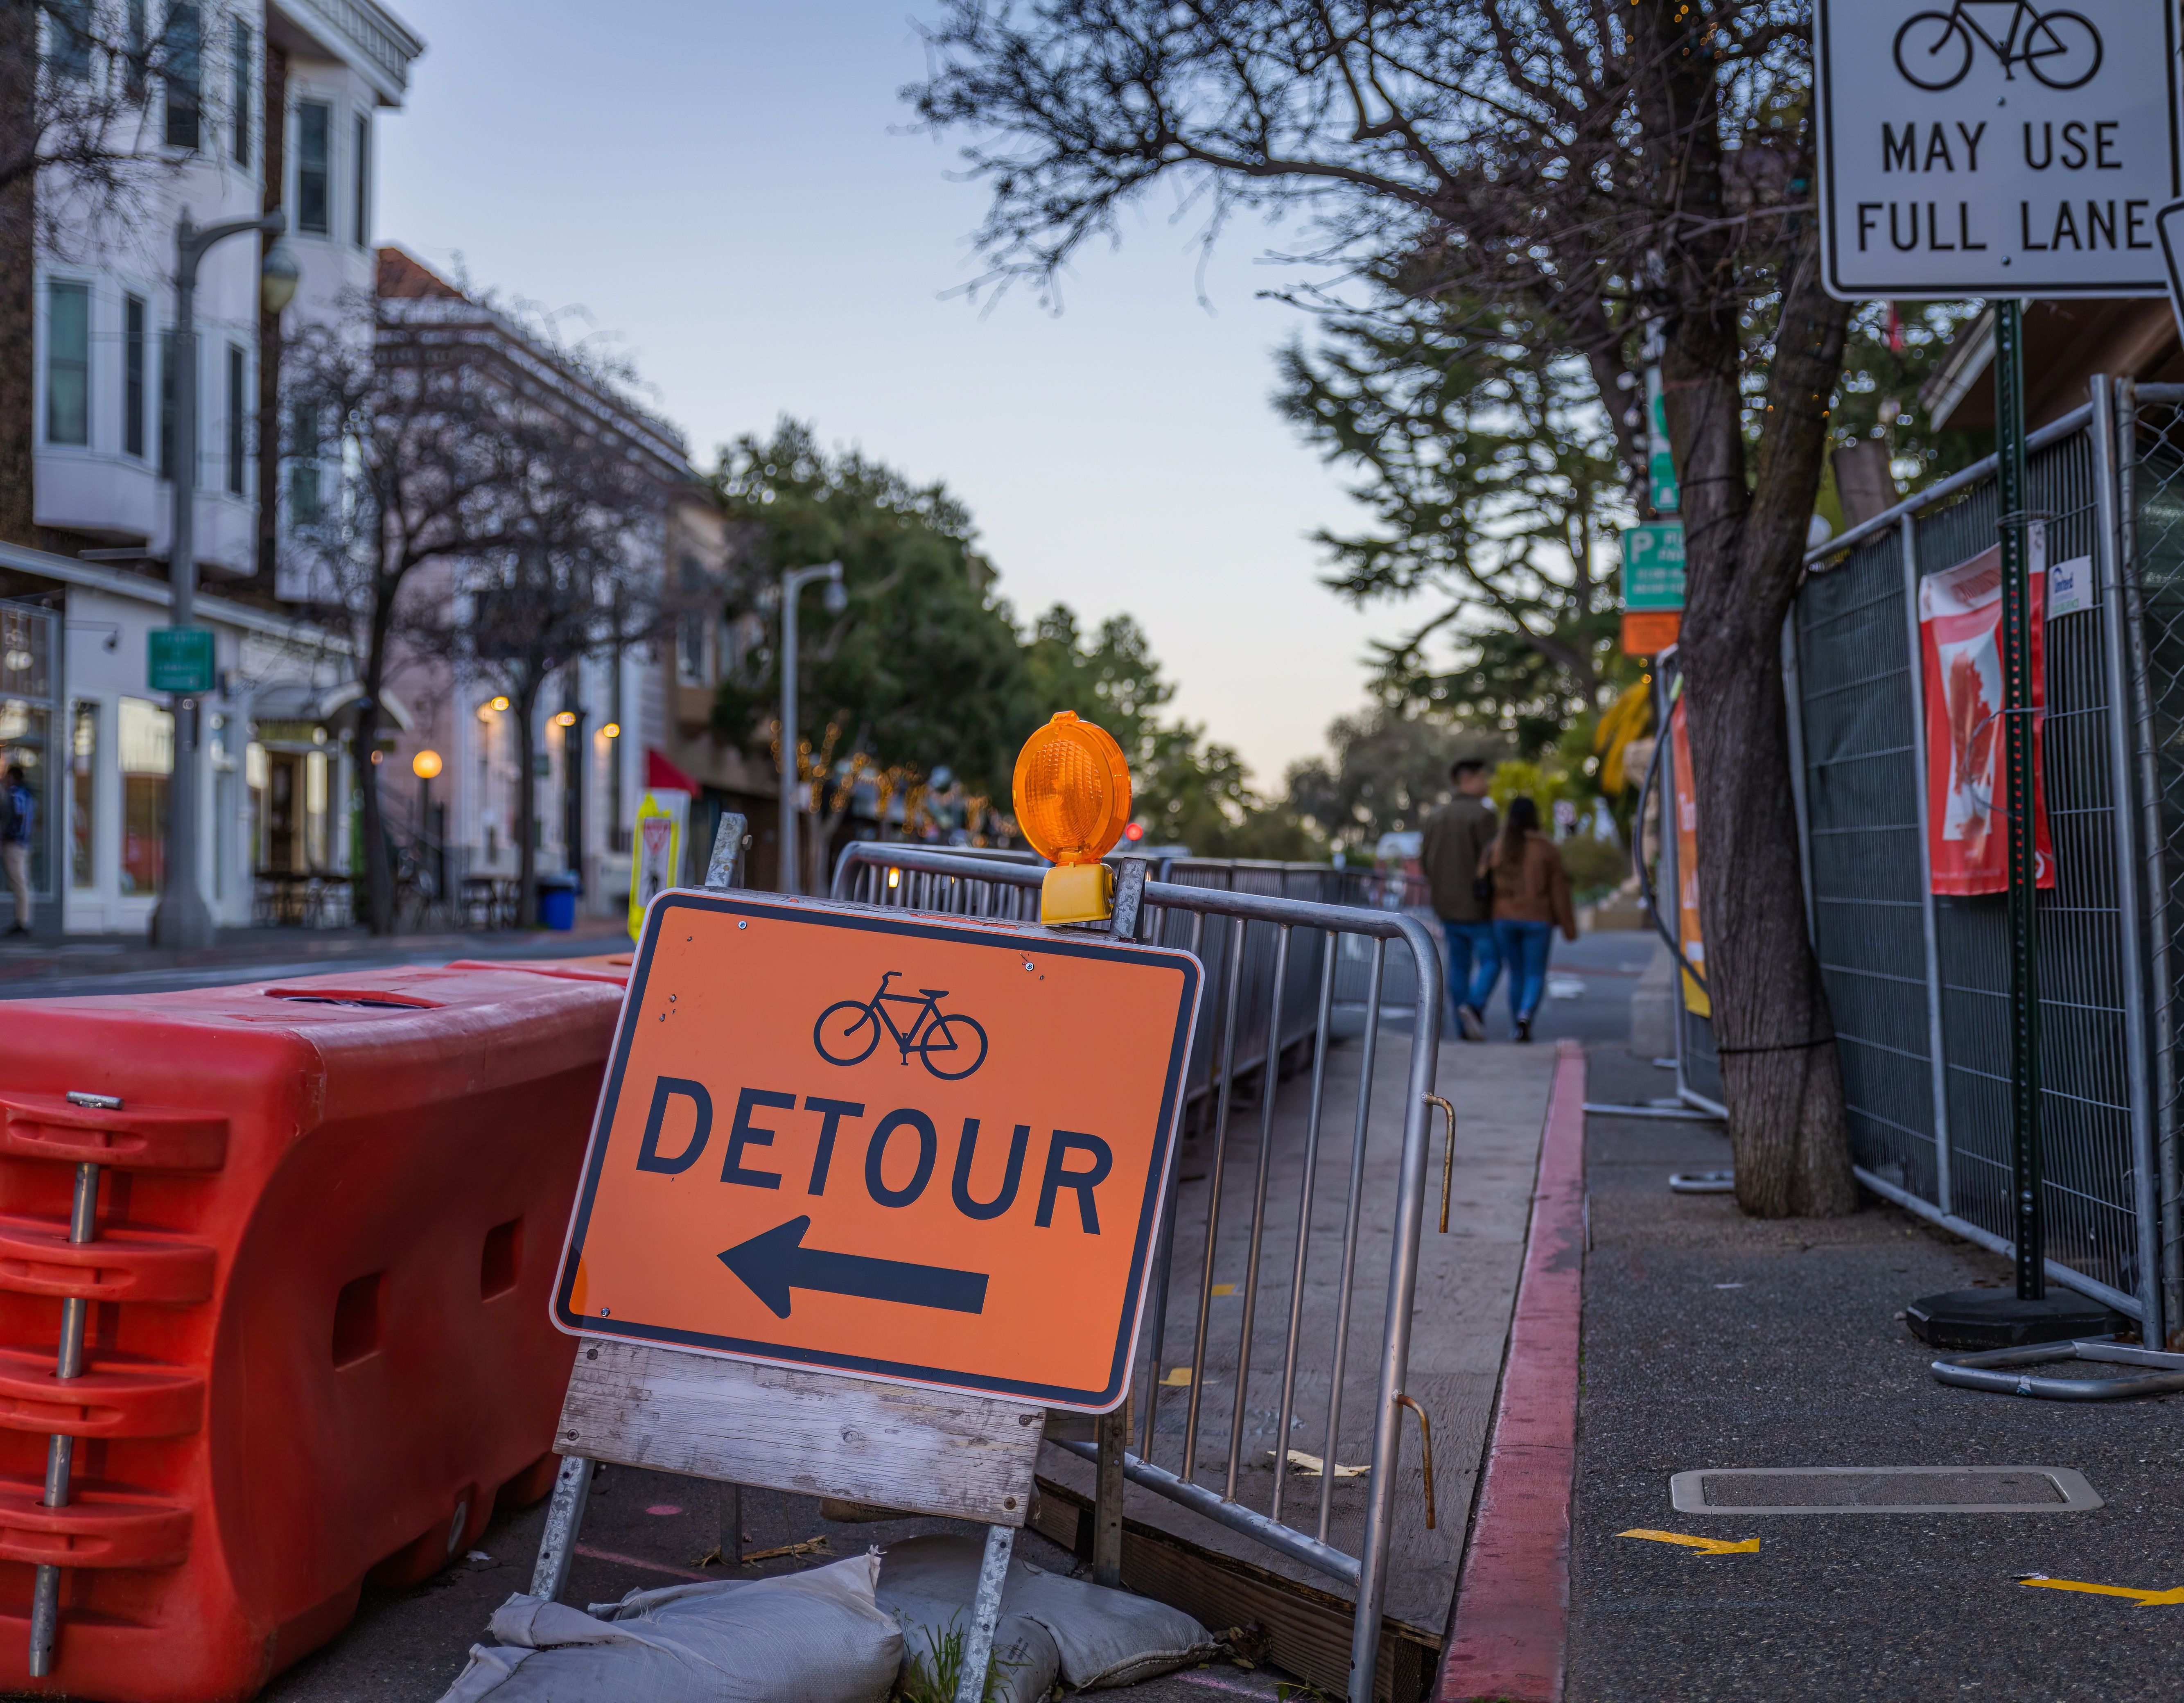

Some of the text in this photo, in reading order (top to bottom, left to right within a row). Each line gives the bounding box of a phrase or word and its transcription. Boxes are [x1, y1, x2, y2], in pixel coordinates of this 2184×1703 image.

[1881, 121, 2123, 172] MAY USE
[1857, 199, 2153, 252] FULL LANE
[636, 1076, 1113, 1235] DETOUR
